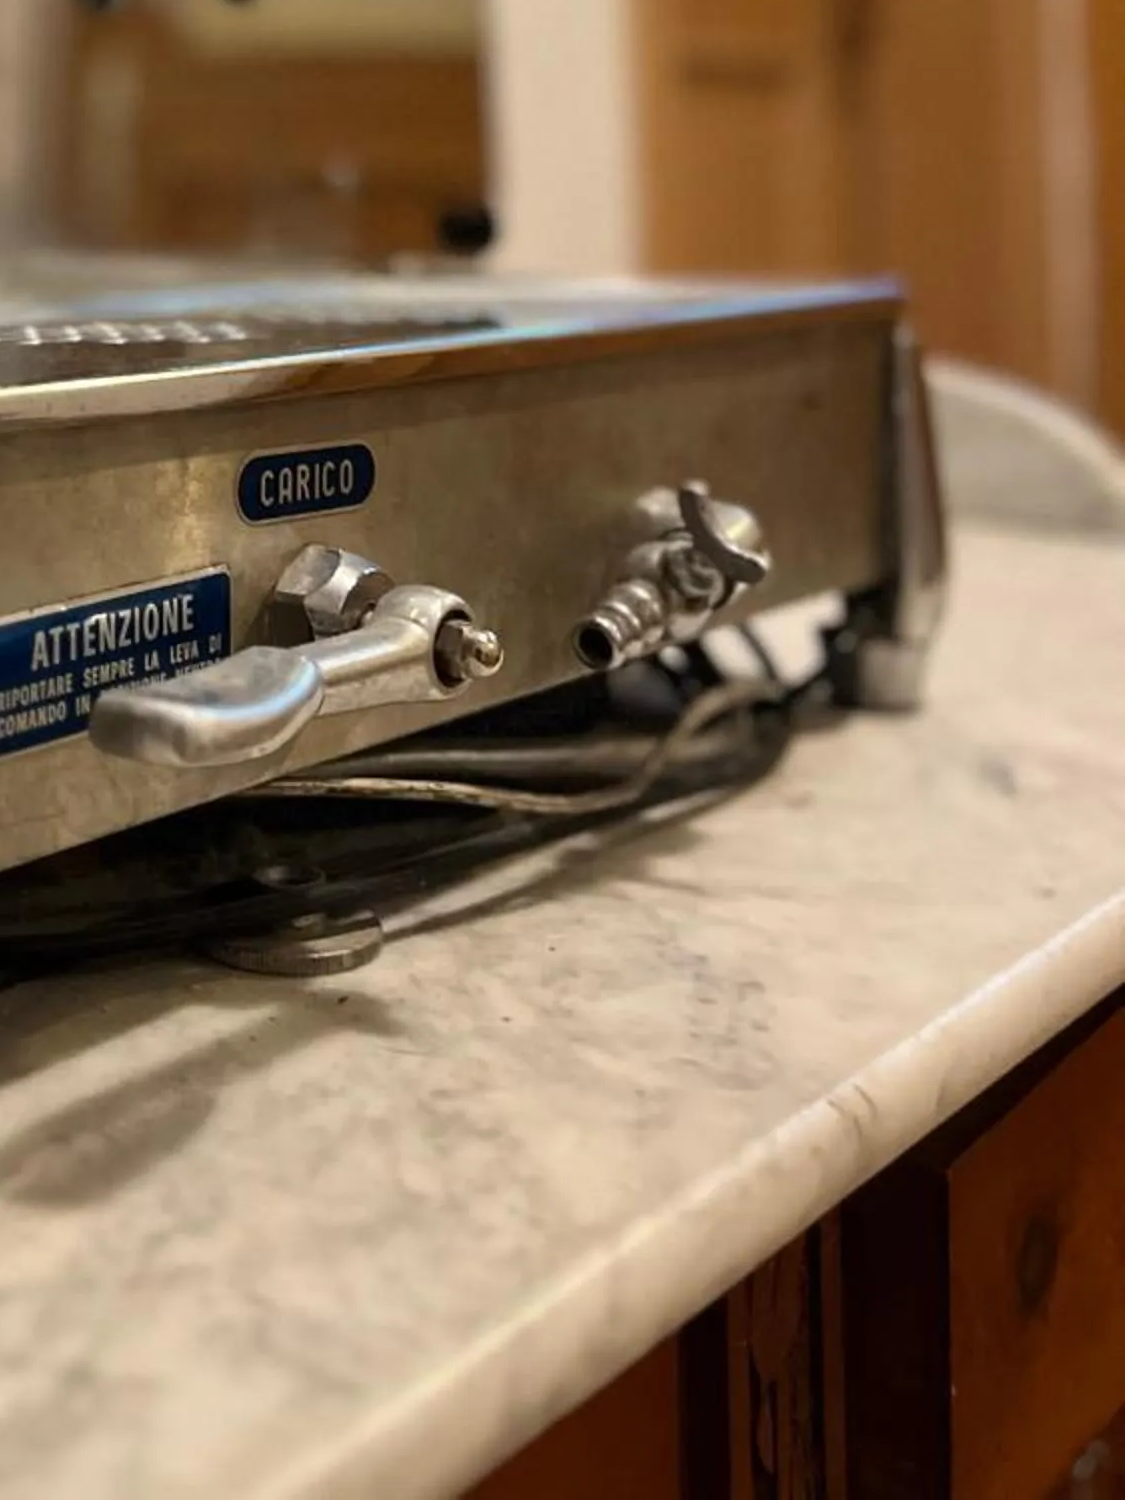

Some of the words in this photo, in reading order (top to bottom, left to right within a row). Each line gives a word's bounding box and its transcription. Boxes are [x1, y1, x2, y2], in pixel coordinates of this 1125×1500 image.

[260, 459, 353, 507] CARICO
[31, 594, 194, 672] ATTENZIONE
[83, 656, 134, 688] SEMPRE
[144, 649, 161, 672] LA
[170, 640, 200, 665] LEVA
[209, 632, 222, 654] DI
[76, 694, 91, 718] IN
